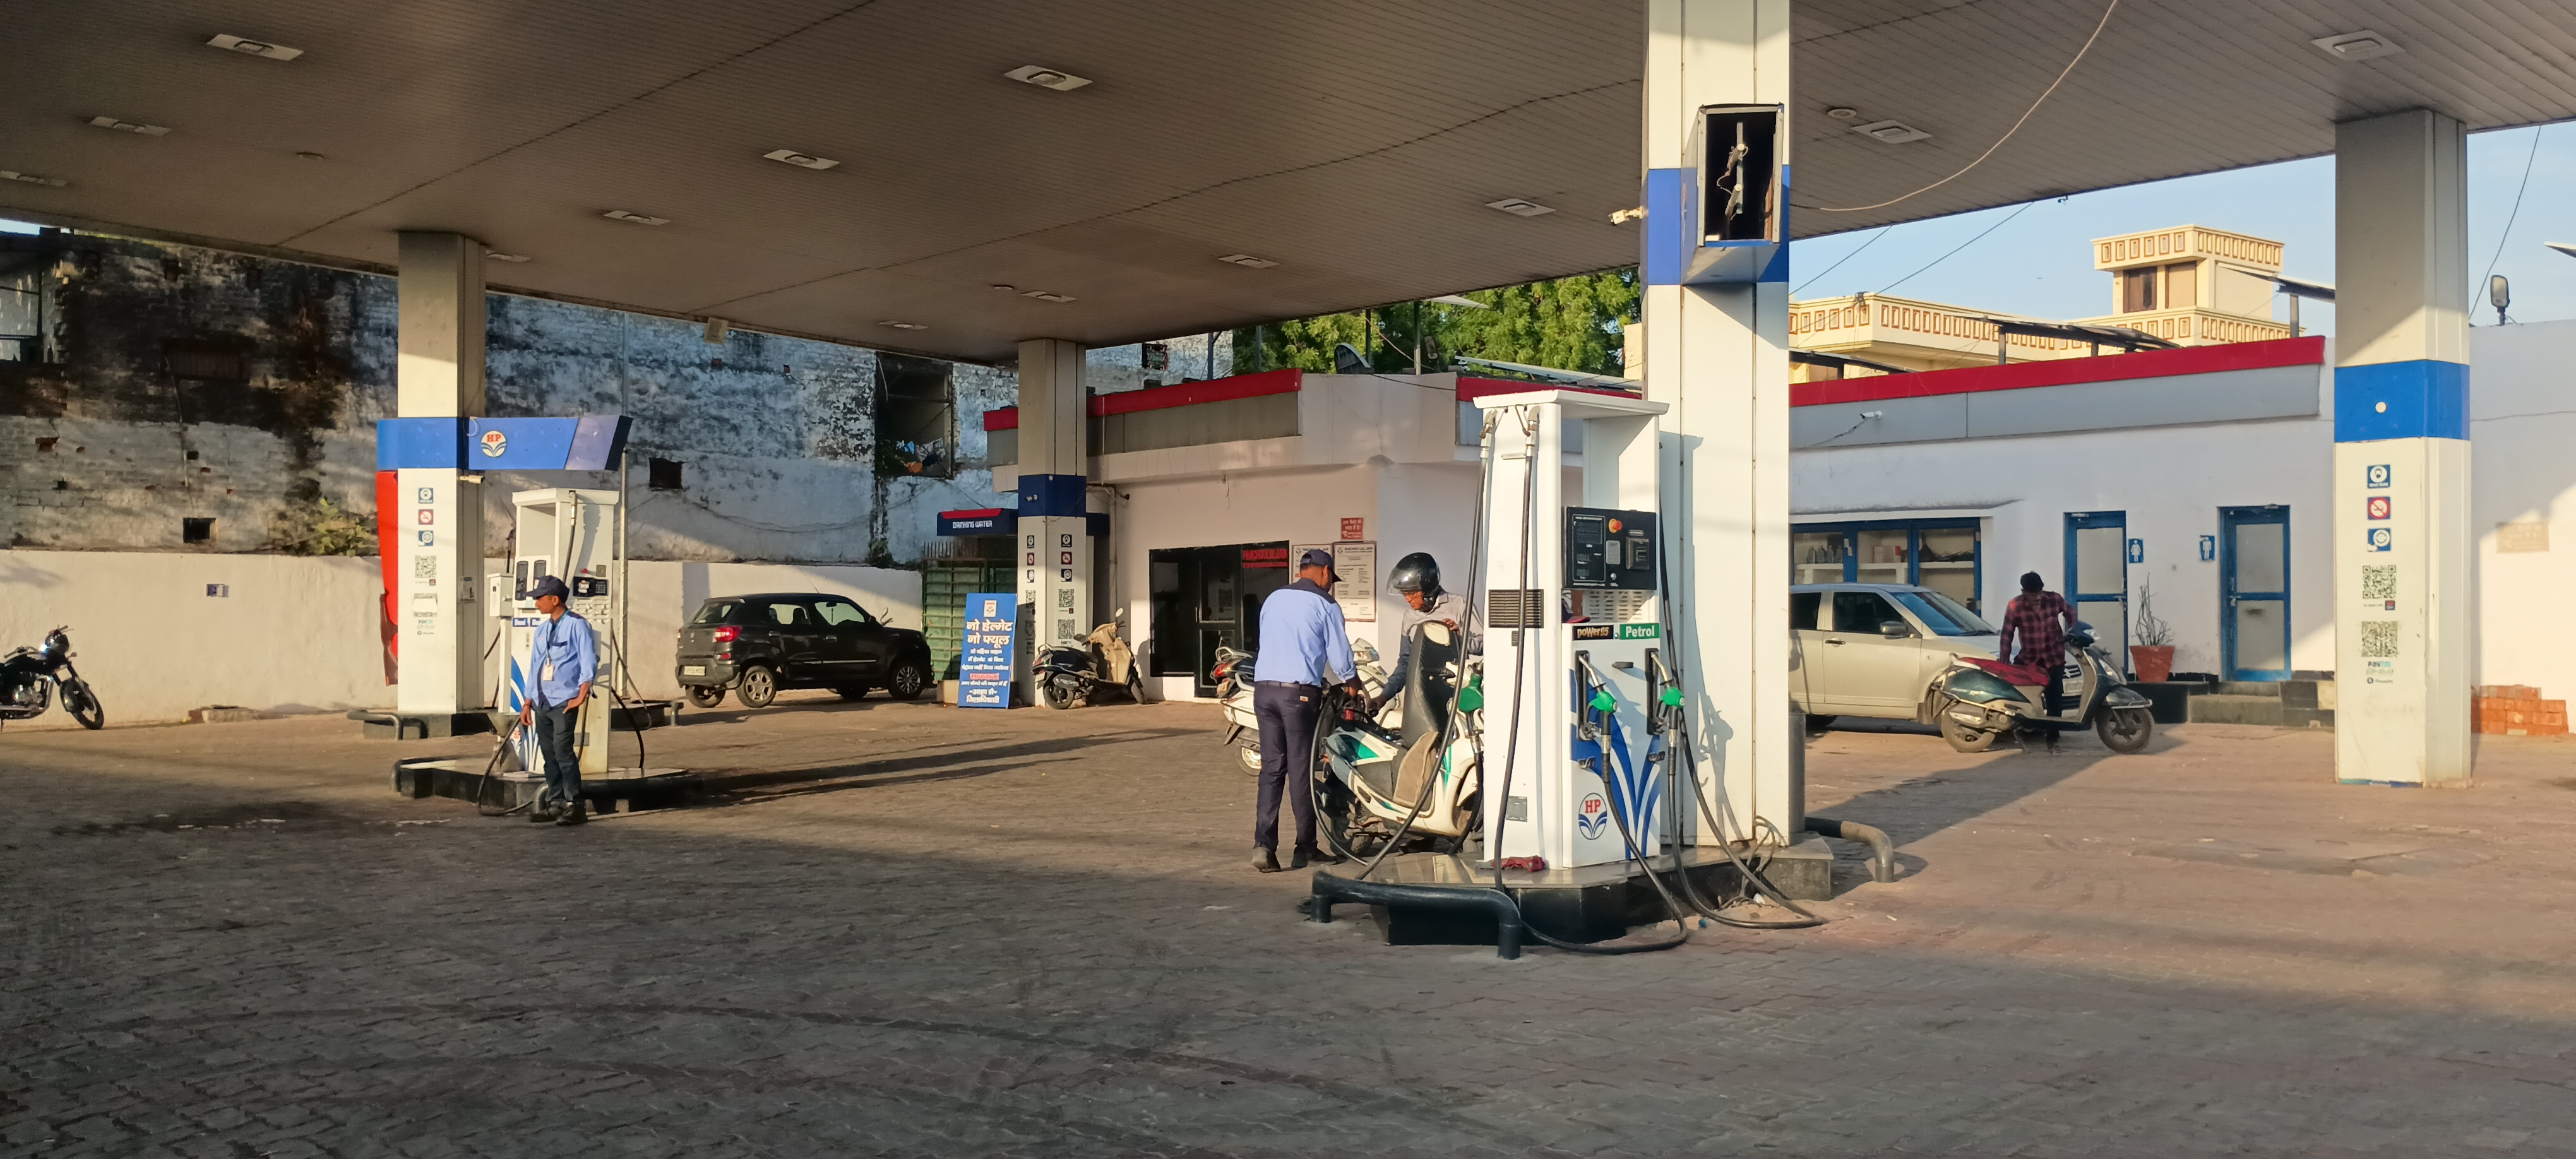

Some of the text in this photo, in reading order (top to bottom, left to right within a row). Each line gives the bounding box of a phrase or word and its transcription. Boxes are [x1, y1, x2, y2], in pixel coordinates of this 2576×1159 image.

[952, 520, 993, 529] DRINKING WATER
[967, 619, 981, 631] नो
[1625, 625, 1655, 638] Petrol
[967, 632, 1011, 649] नो फ्यूल
[1585, 799, 1601, 814] HP
